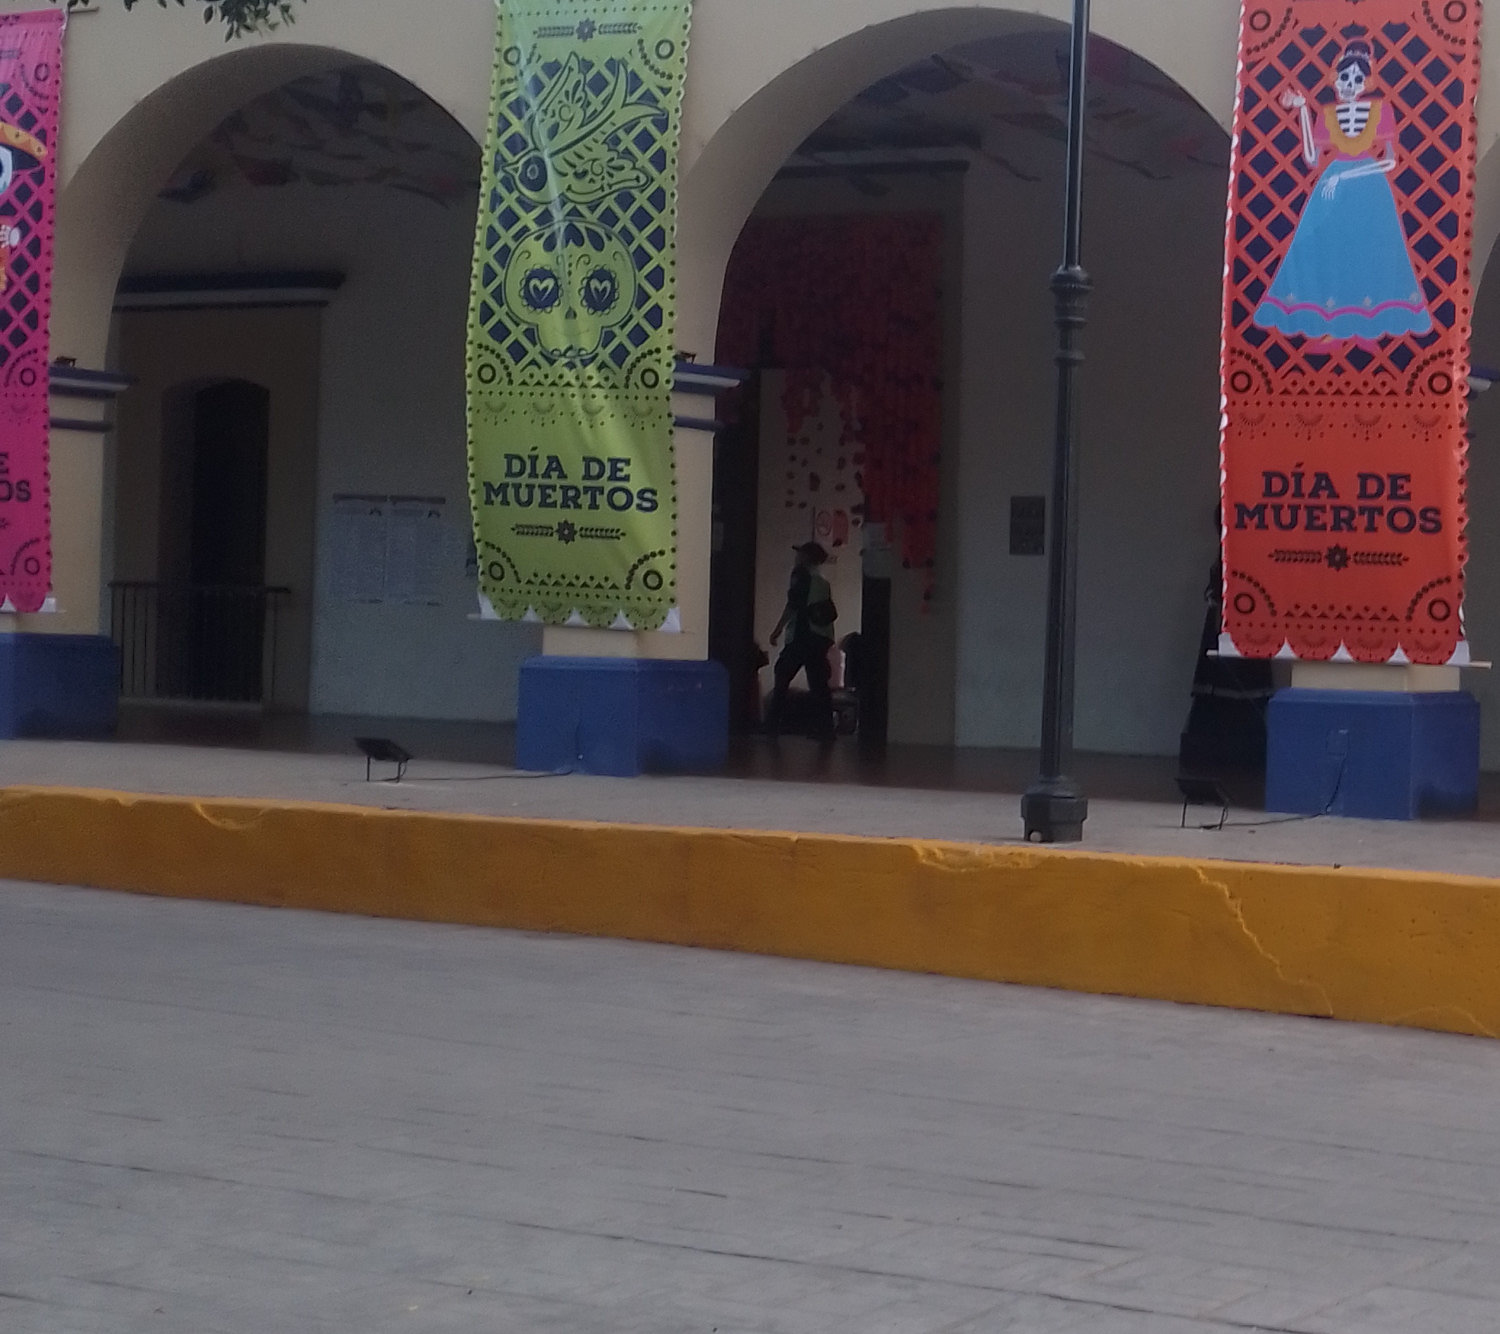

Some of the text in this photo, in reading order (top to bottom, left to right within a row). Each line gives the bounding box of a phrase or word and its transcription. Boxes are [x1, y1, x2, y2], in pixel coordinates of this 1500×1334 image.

[504, 446, 631, 482] DÍA DE
[483, 481, 659, 513] MUERTOS
[1262, 462, 1412, 501] DÍA DE
[1234, 503, 1443, 534] MUERTOS
